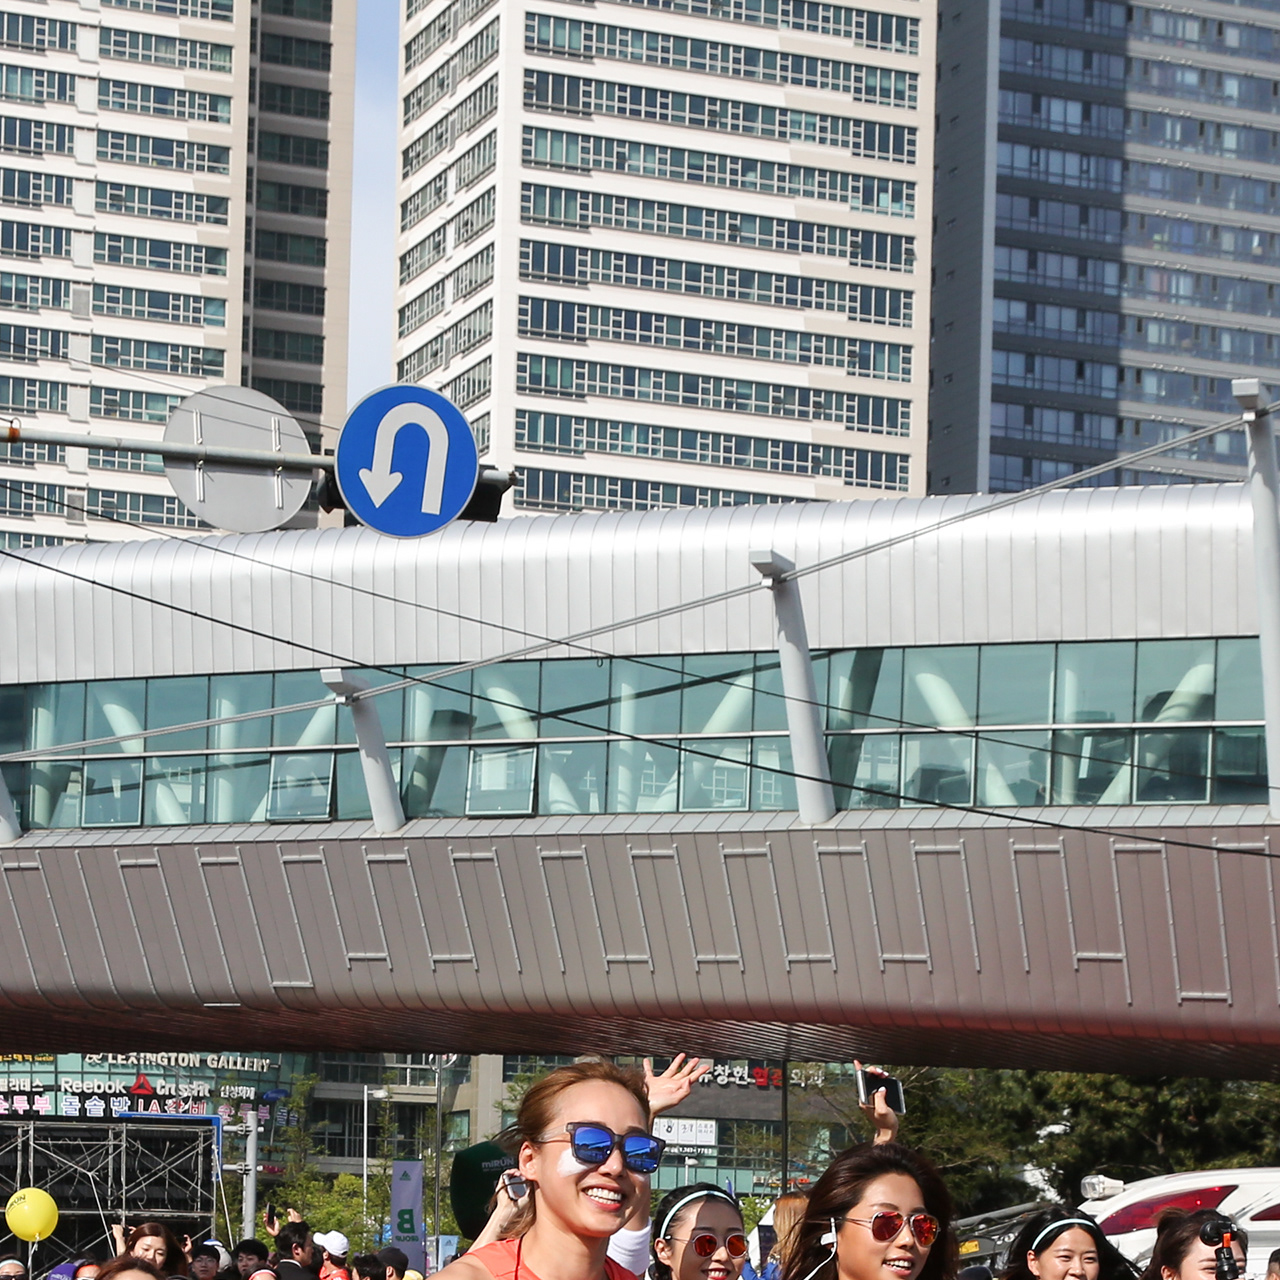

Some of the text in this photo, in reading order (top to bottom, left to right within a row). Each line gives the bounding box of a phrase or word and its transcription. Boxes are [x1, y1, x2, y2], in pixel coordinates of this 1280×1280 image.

[108, 1053, 201, 1068] LEXINGTON
[206, 1055, 270, 1072] GALLERY
[60, 1077, 126, 1094] Reebok
